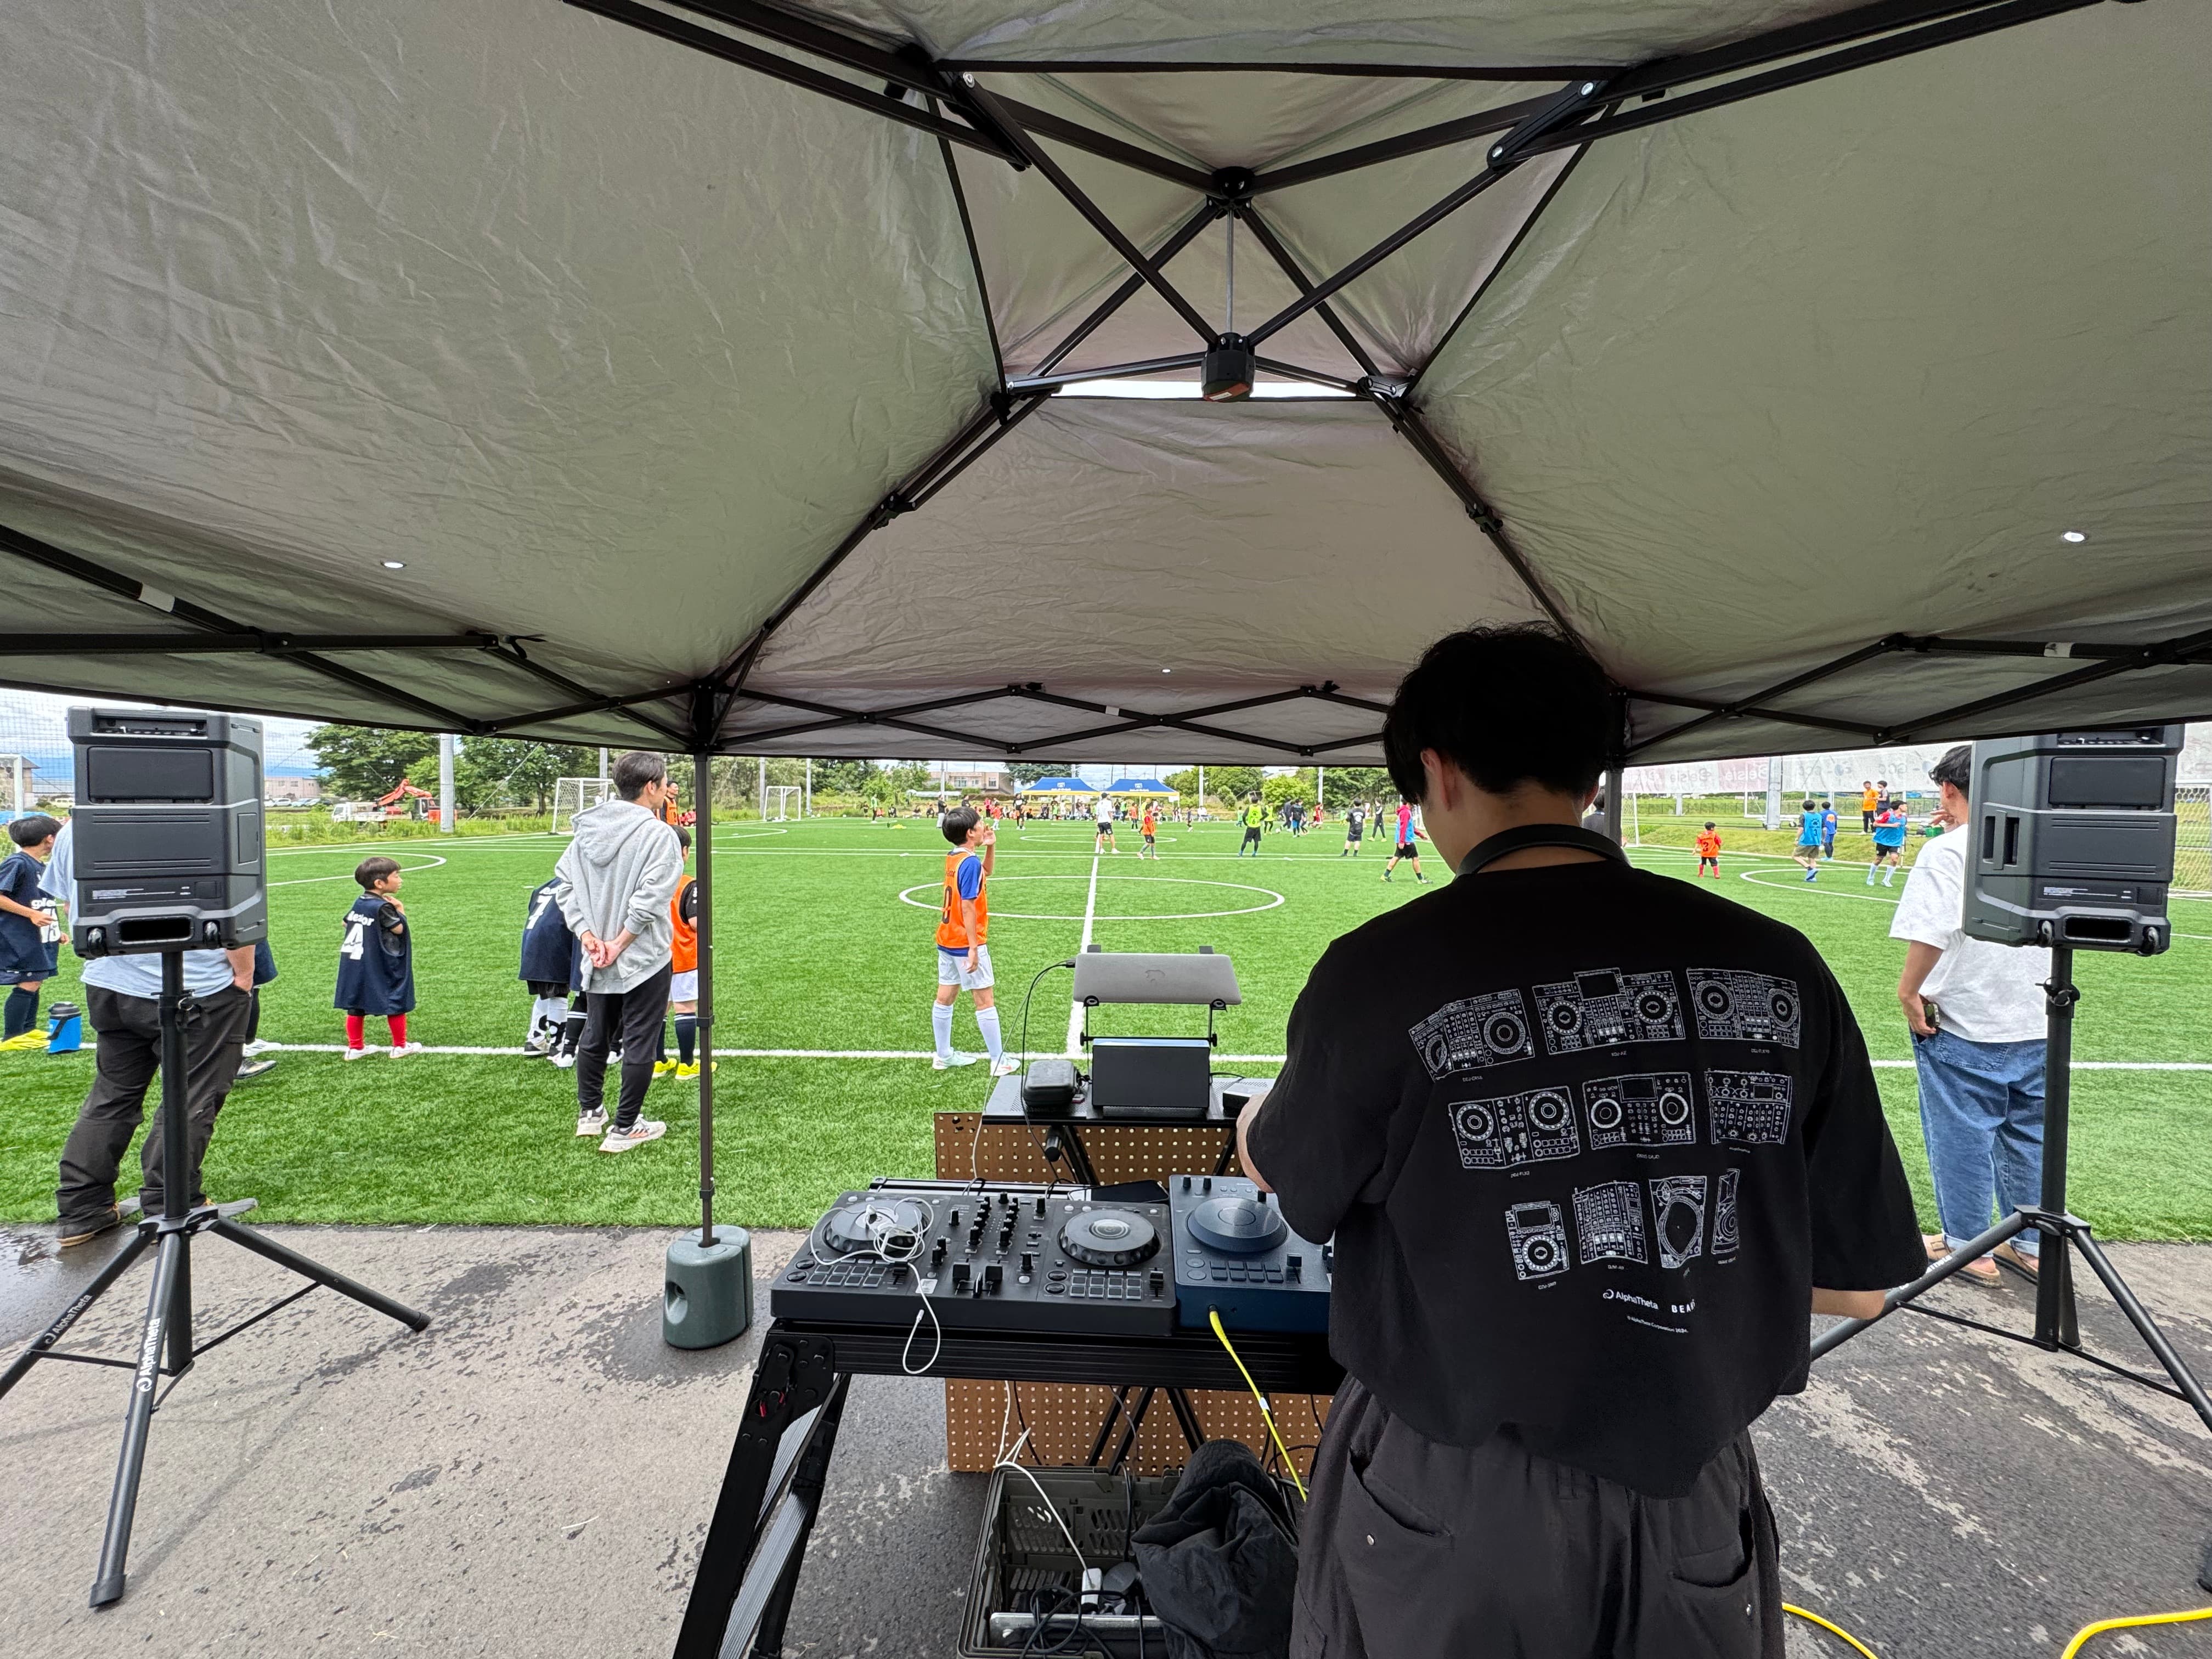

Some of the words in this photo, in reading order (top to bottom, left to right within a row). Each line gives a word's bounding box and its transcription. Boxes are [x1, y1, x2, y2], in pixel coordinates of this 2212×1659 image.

[527, 895, 552, 929] 7
[341, 923, 364, 960] 4
[53, 1295, 92, 1333] AlphaTheta
[1616, 1291, 1659, 1310] AlphaTheta
[139, 1318, 161, 1376] AlphaTheta
